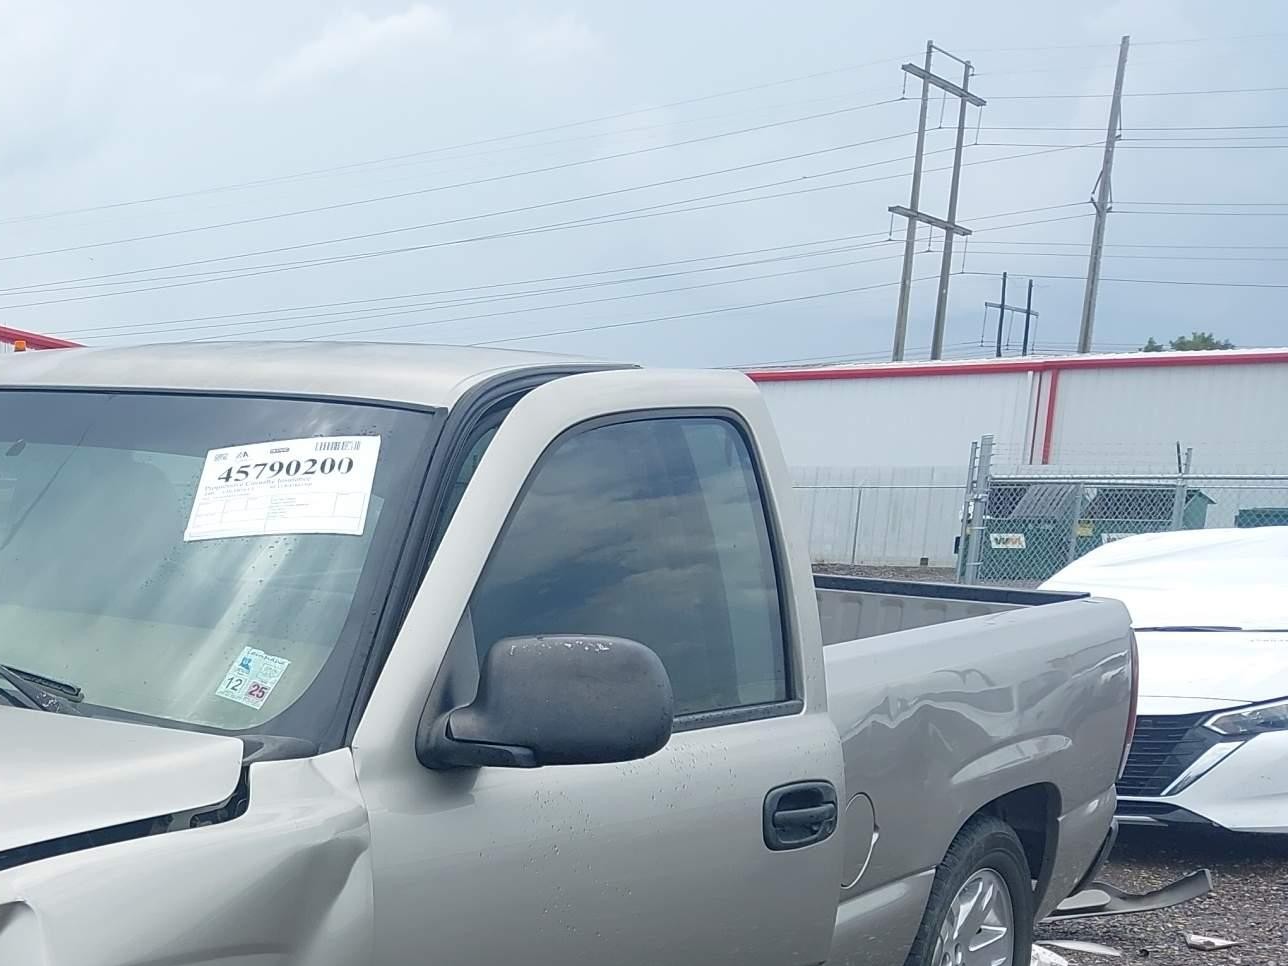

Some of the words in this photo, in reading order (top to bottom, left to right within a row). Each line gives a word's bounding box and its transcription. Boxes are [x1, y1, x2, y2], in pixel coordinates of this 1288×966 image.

[217, 456, 354, 483] 45790200
[225, 677, 243, 691] 12
[248, 683, 268, 699] 25
